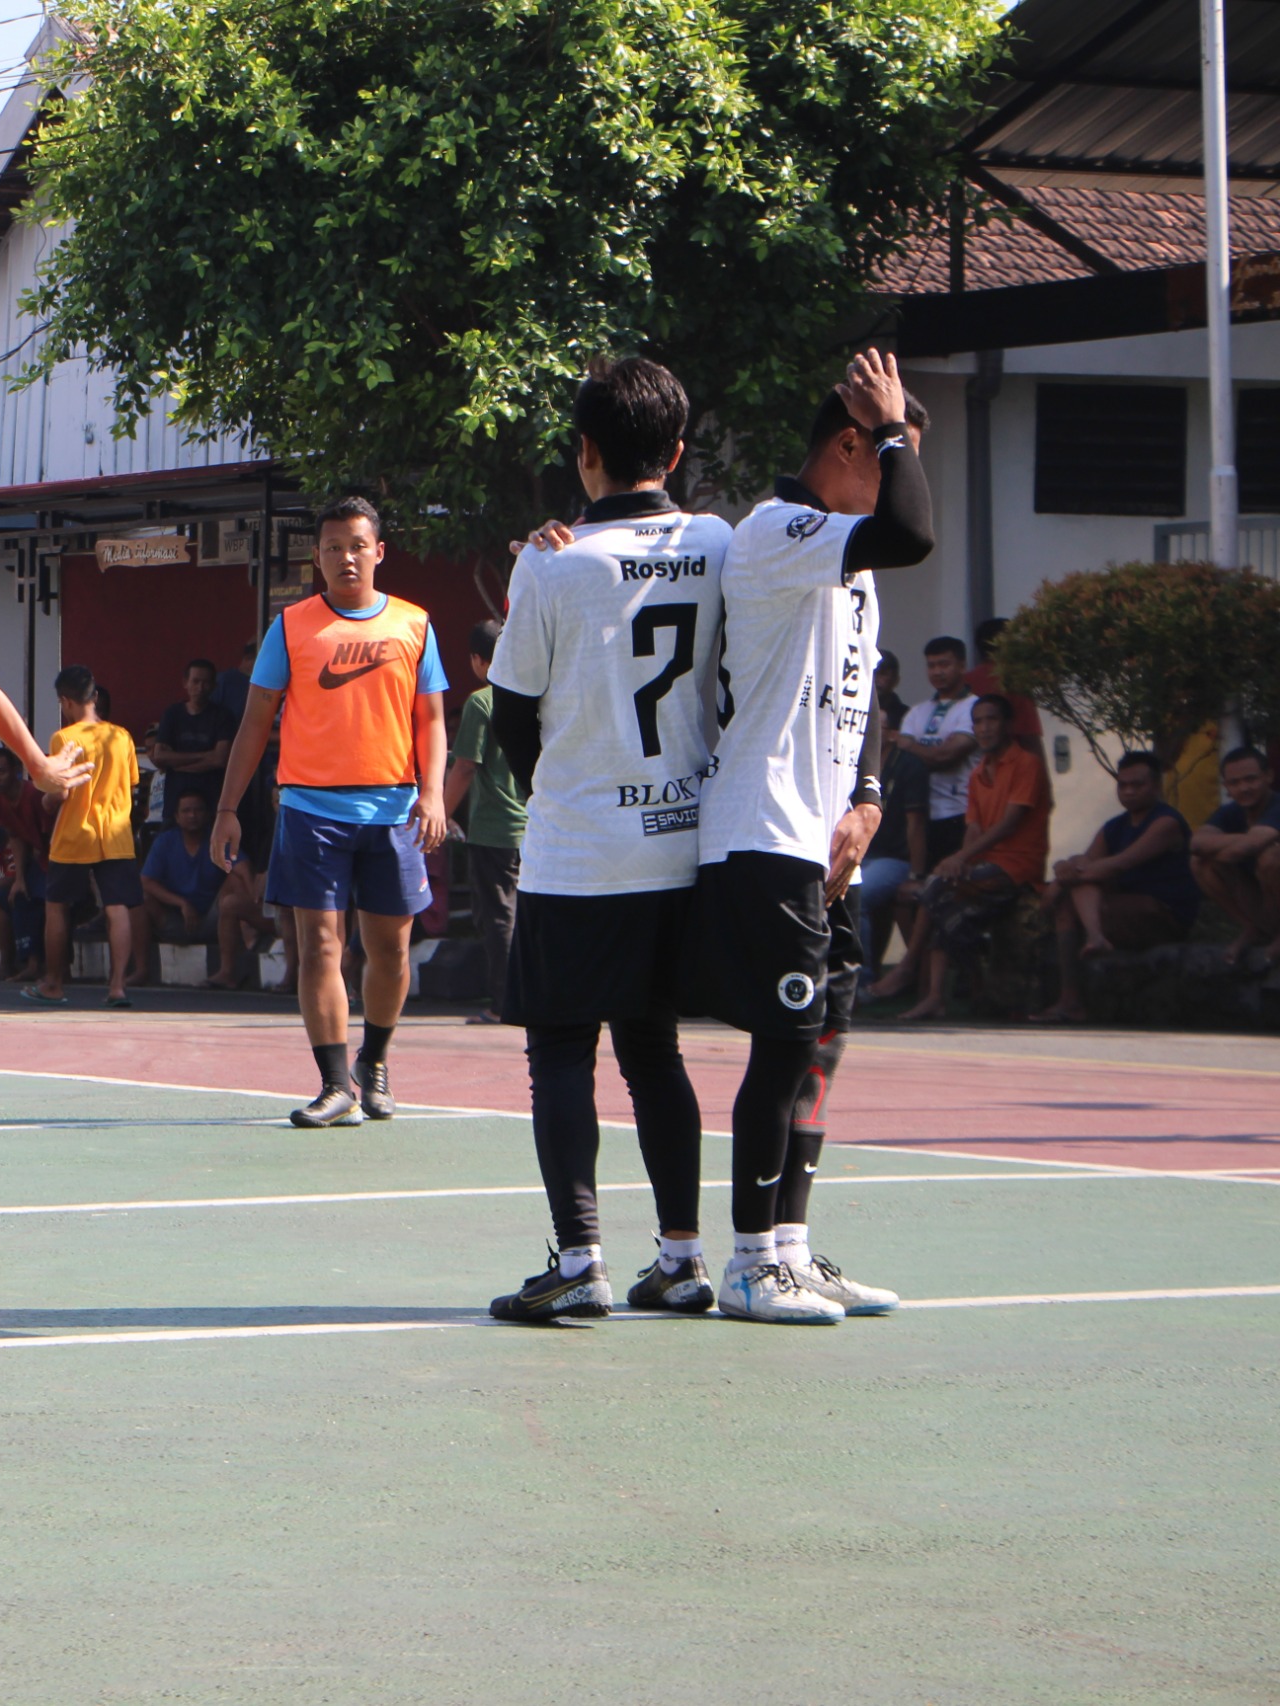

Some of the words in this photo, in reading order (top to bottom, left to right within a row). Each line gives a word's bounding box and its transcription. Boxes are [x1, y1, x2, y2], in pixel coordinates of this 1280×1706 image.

[620, 555, 706, 582] Rosyid
[331, 641, 389, 665] NIKE
[632, 603, 698, 758] 7
[616, 776, 697, 807] BLOK
[658, 809, 698, 826] SAVIO
